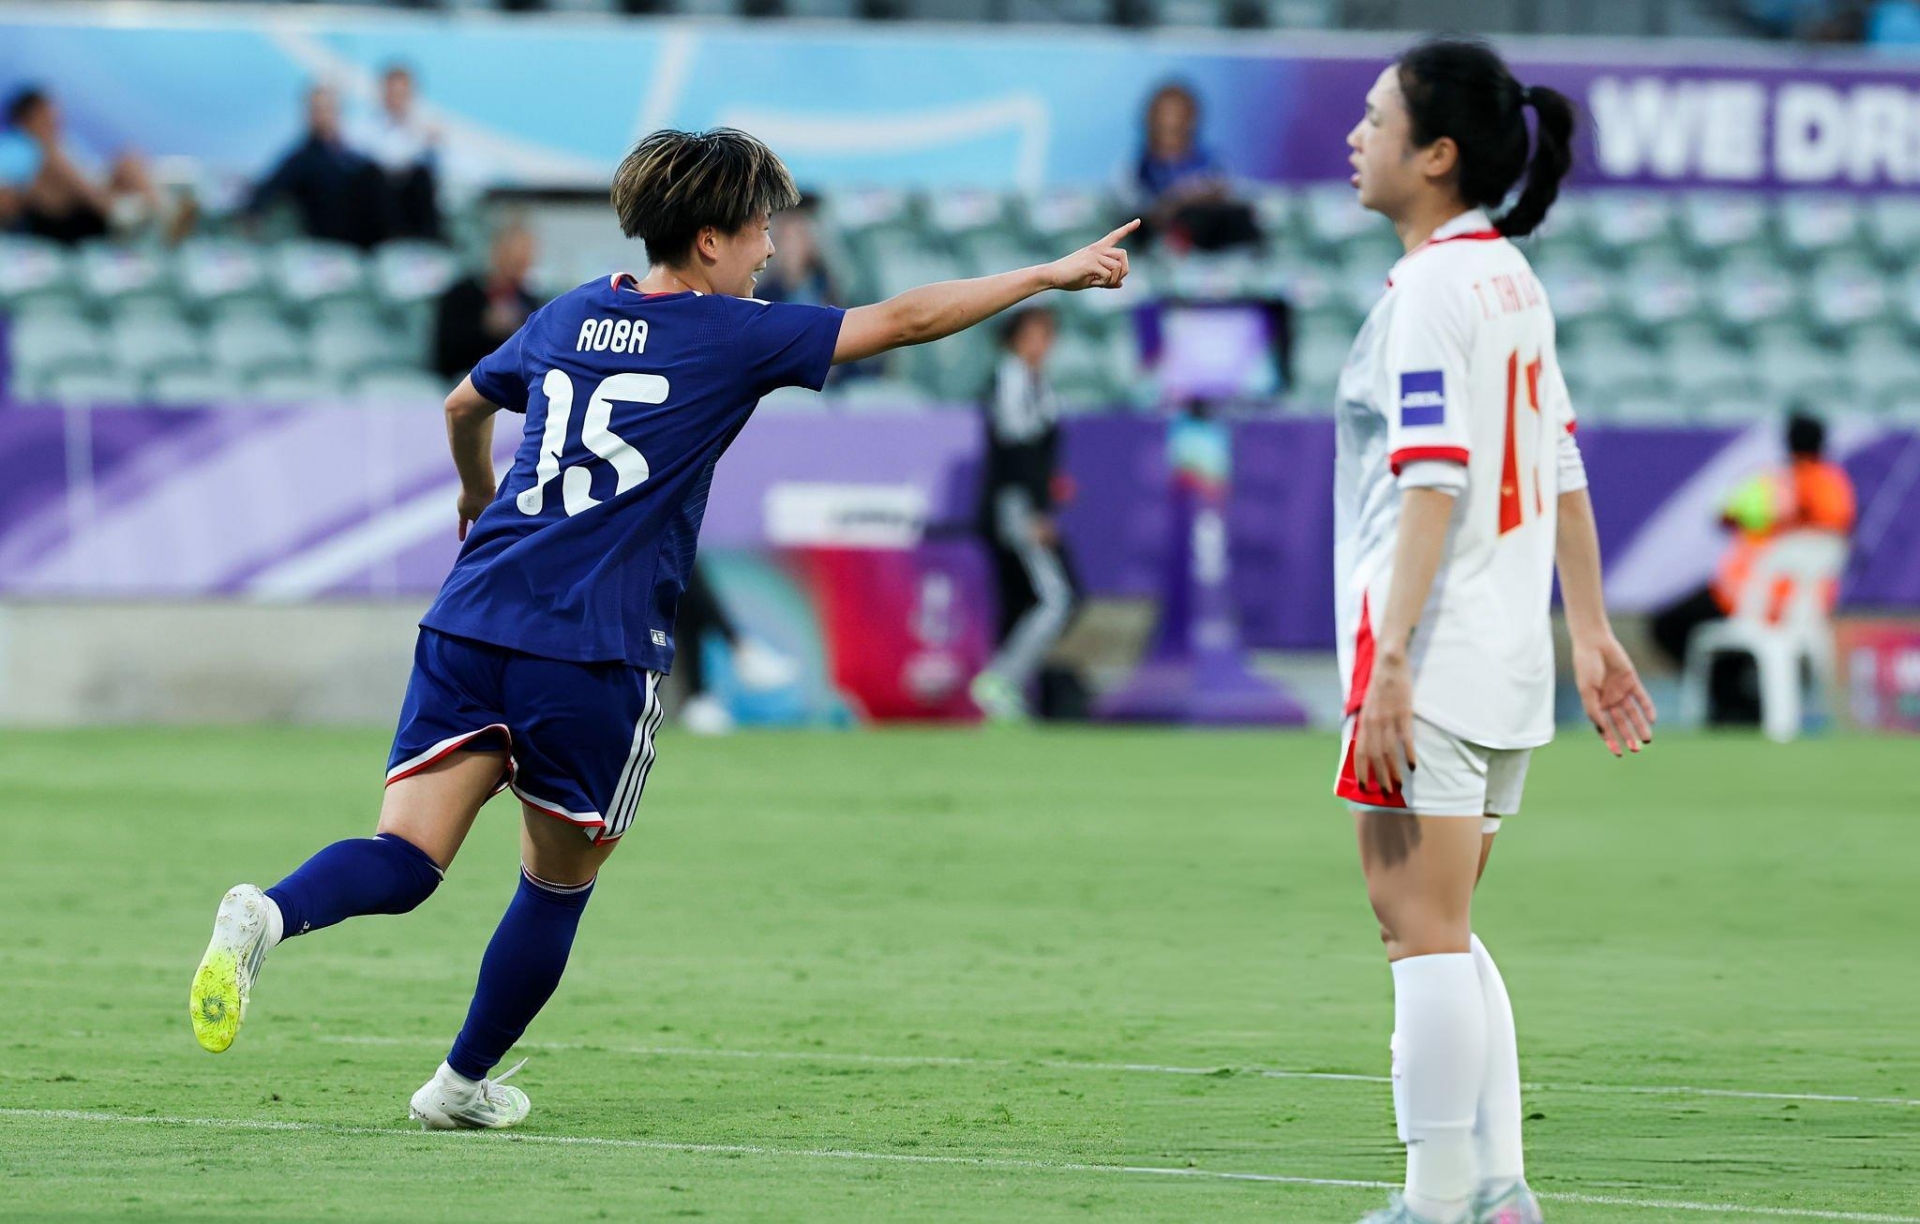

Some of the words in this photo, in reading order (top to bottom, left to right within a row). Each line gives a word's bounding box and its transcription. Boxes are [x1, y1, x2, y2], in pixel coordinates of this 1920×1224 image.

[1590, 77, 1767, 179] WE
[1775, 82, 1920, 181] DR
[576, 318, 649, 353] AOBA
[517, 368, 670, 517] 15
